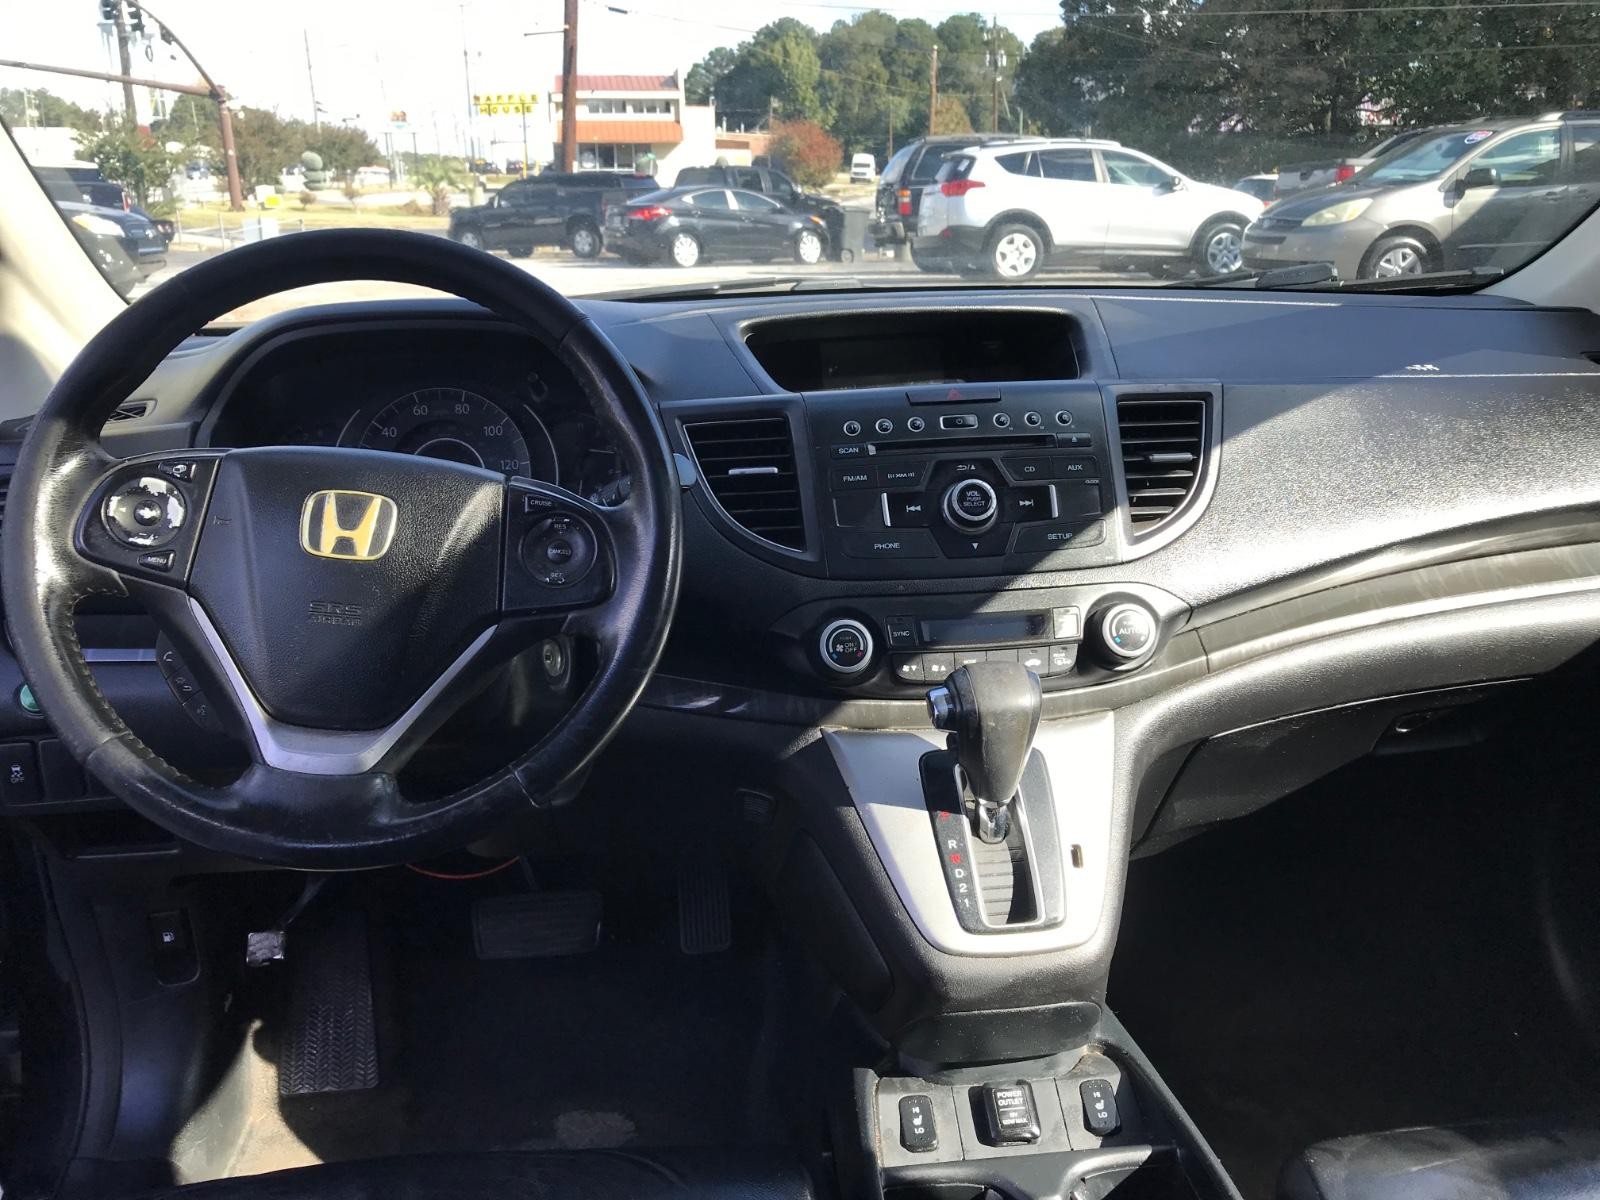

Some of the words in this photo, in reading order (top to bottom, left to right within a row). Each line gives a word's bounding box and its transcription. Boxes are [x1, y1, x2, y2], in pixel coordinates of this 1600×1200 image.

[413, 405, 428, 416] 60
[455, 403, 470, 414] 80
[382, 427, 397, 438] 40
[483, 426, 503, 437] 100
[501, 460, 519, 470] 120
[843, 474, 868, 482] FM/AM
[530, 499, 552, 507] CRUISE
[1047, 532, 1073, 540] SETUP
[874, 542, 901, 550] PHONE
[147, 556, 167, 564] MENU
[948, 840, 958, 849] R
[954, 868, 964, 878] D
[959, 882, 968, 893] 2
[964, 898, 970, 908] 1
[997, 1090, 1022, 1098] POWER
[998, 1098, 1024, 1106] OUTLET
